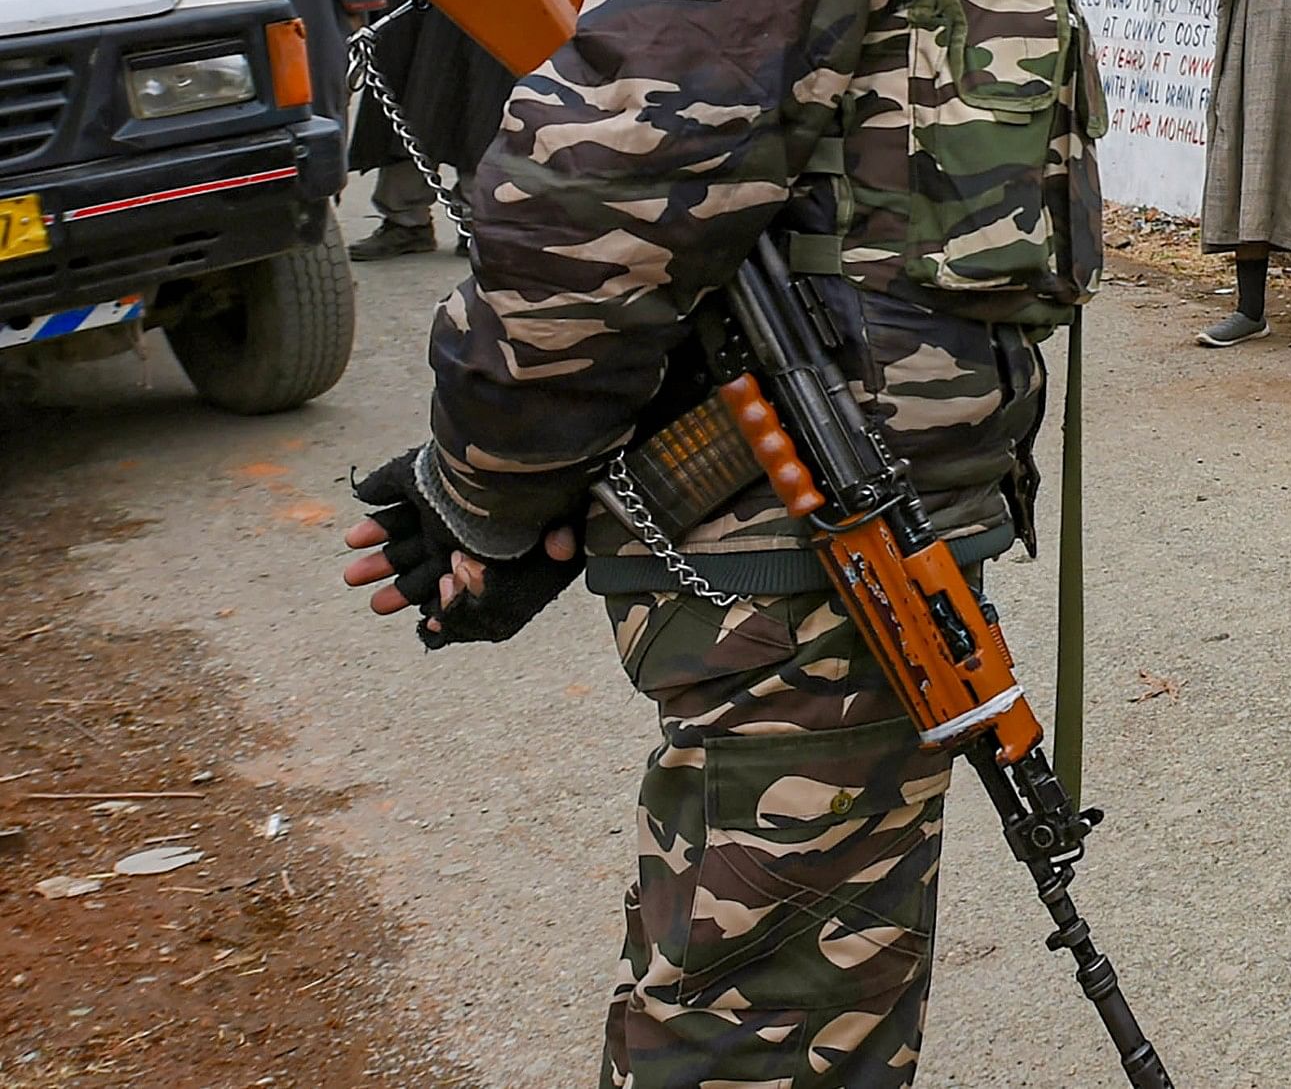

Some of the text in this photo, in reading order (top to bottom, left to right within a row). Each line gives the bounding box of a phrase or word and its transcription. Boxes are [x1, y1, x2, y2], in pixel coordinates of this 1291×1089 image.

[1102, 16, 1118, 38] AT
[1124, 17, 1167, 45] CWWC
[1152, 52, 1172, 75] AT
[1179, 55, 1214, 79] CWW
[1111, 109, 1206, 146] AT DAR MOHALL
